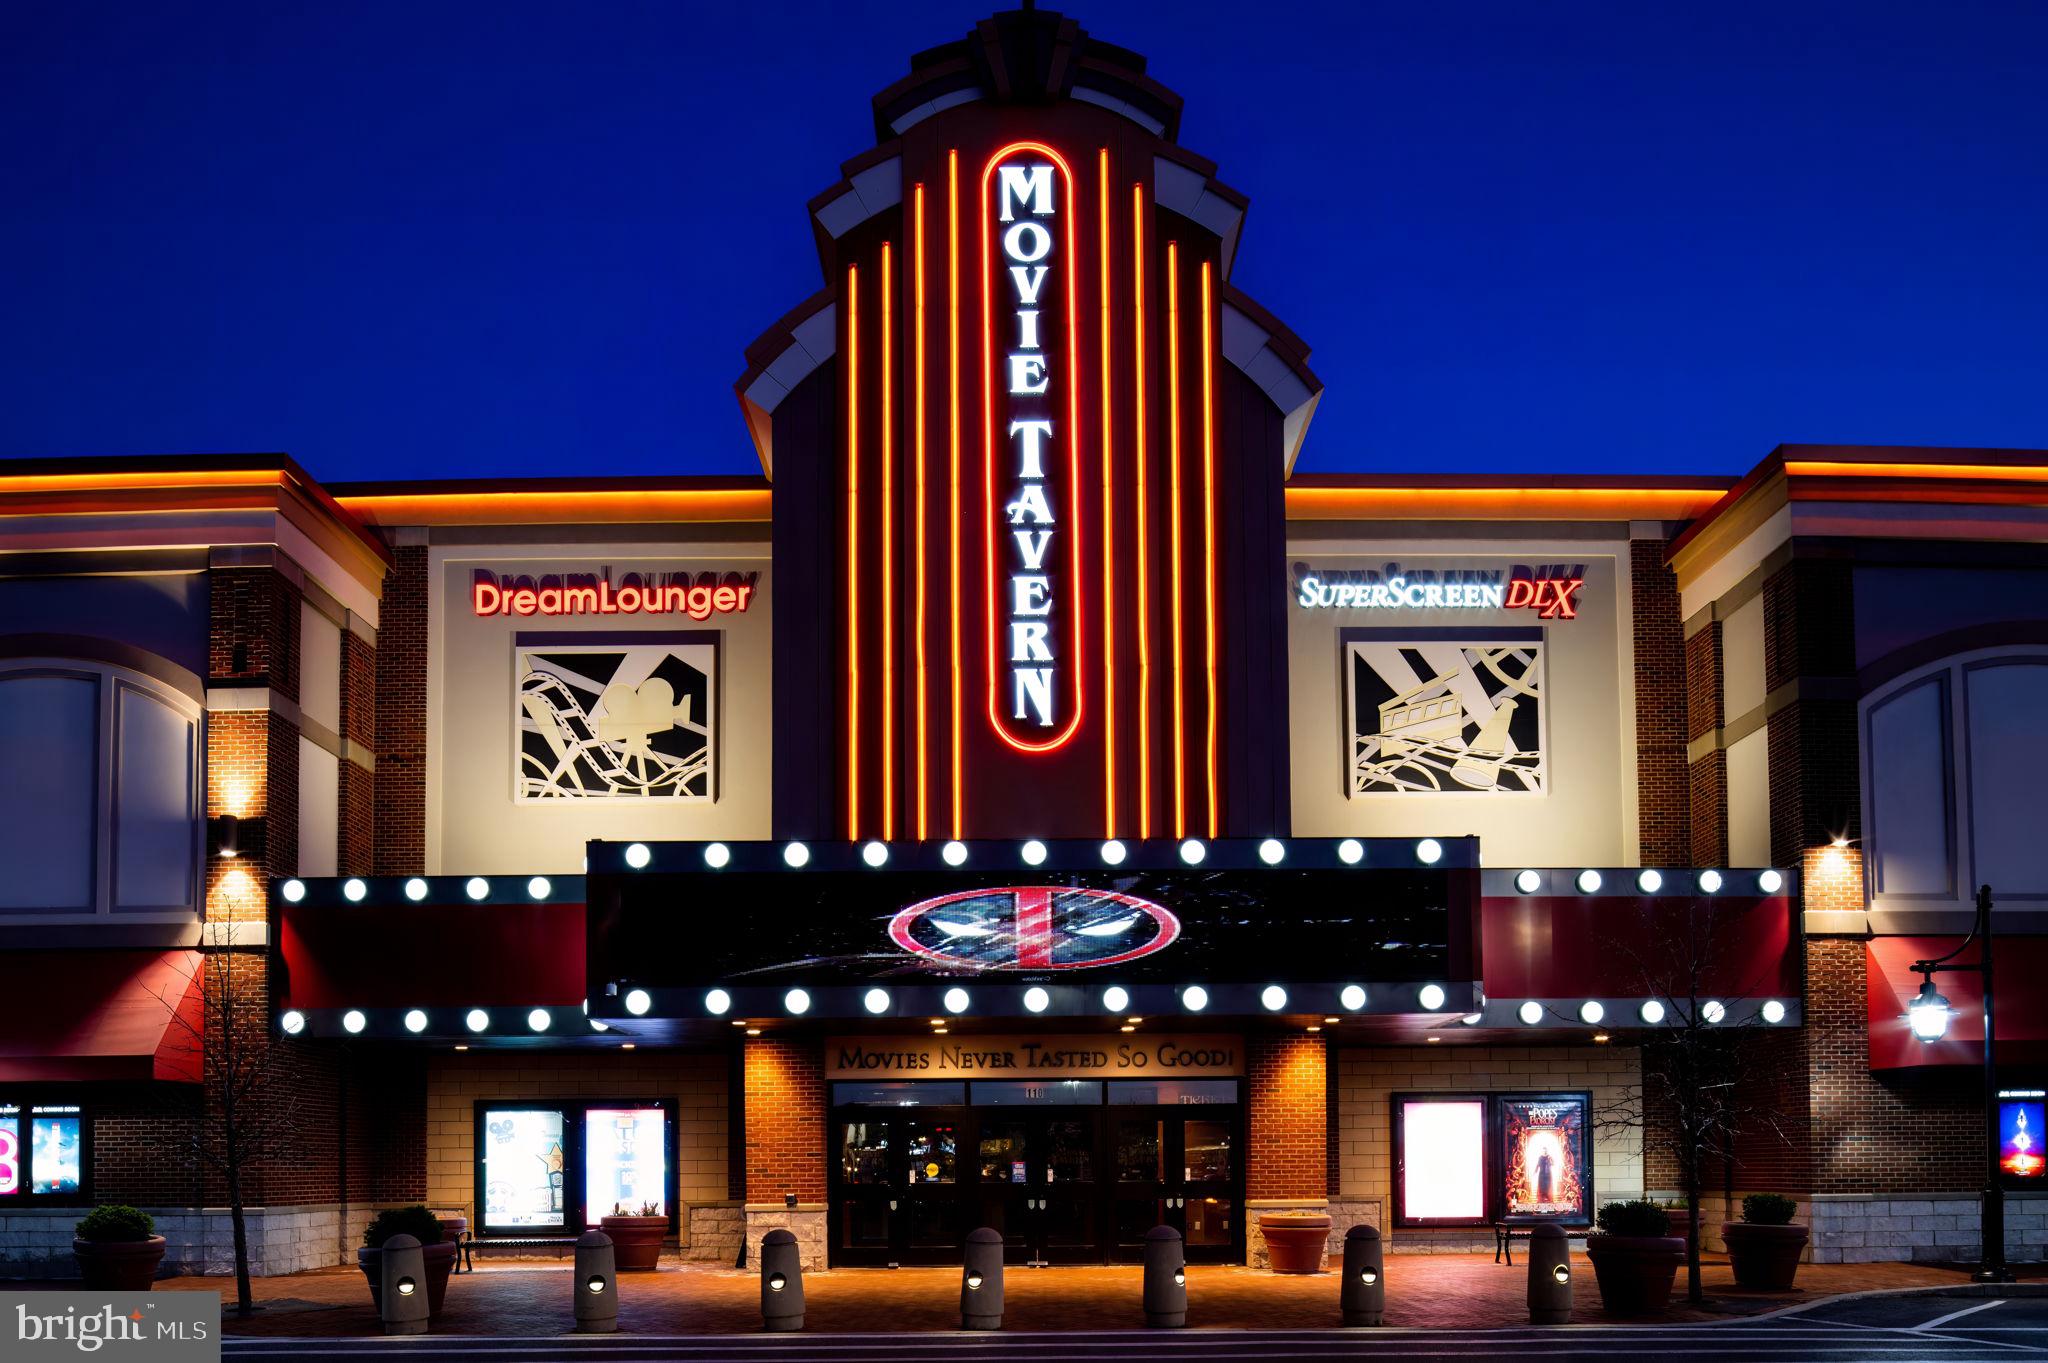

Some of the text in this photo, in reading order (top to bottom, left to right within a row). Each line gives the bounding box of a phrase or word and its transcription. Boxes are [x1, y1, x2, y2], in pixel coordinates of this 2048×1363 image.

[999, 166, 1055, 727] MOVIE TAVERN
[474, 581, 752, 621] DreamLounger
[1299, 577, 1583, 618] SUPERSCREEN DLX
[837, 1047, 930, 1070] MOVIES
[939, 1046, 1017, 1069] NEVER
[1021, 1043, 1108, 1069] TASTED
[1157, 1044, 1234, 1068] GOOD!
